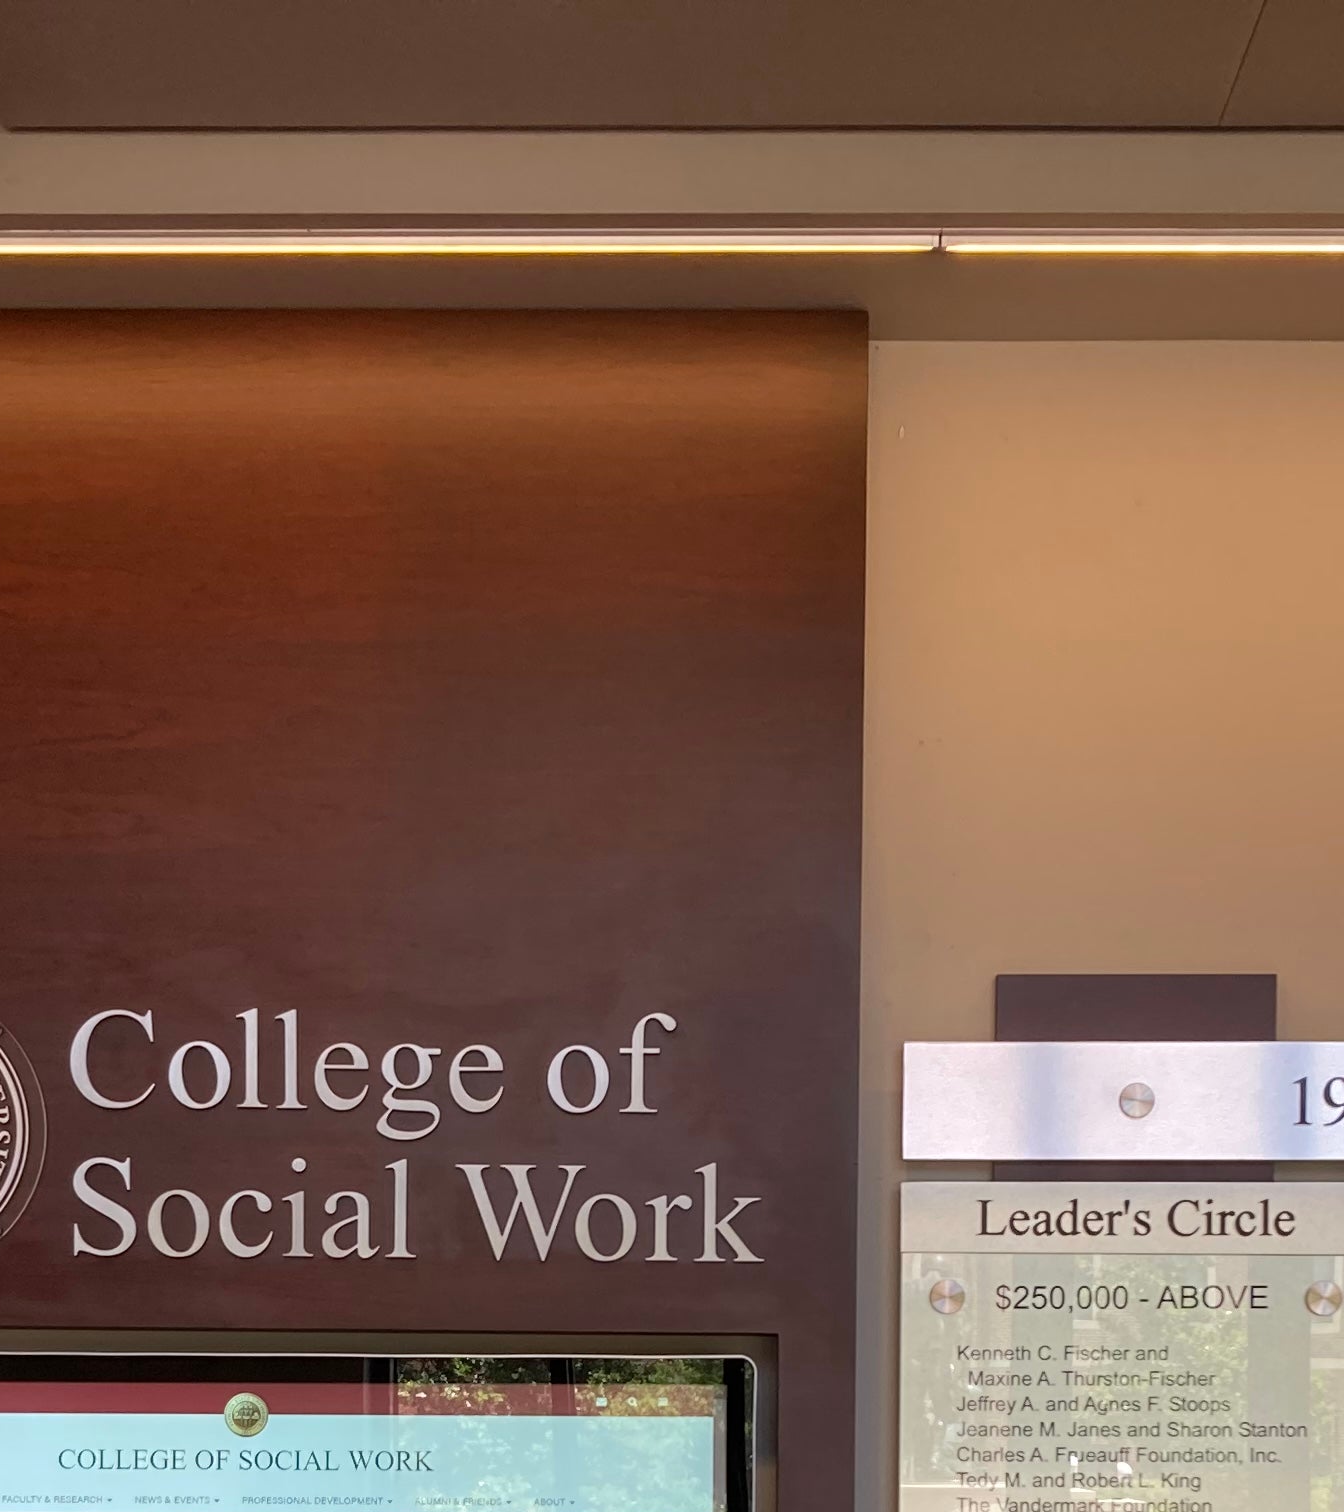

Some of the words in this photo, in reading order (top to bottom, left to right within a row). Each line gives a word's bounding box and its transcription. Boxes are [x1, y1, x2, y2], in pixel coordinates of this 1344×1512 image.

[69, 1007, 505, 1140] College
[547, 1012, 678, 1113] of
[71, 1155, 416, 1259] Social
[455, 1161, 765, 1263] Work
[976, 1198, 1152, 1237] Leader's
[1167, 1198, 1296, 1237] Circle
[996, 1284, 1129, 1313] $250,000
[1157, 1284, 1268, 1309] ABOVE
[957, 1344, 1031, 1361] Kenneth
[1037, 1345, 1057, 1361] C.
[1064, 1345, 1129, 1362] Fischer
[1135, 1345, 1168, 1362] and
[968, 1370, 1032, 1387] Maxine
[1036, 1370, 1056, 1386] A.
[1062, 1371, 1216, 1387] Thurston-Fischer
[956, 1421, 1034, 1438] Jeanene
[1040, 1421, 1060, 1438] M.
[1068, 1421, 1121, 1438] Janes
[1127, 1421, 1161, 1438] and
[1166, 1421, 1232, 1438] Sharon
[1238, 1421, 1308, 1439] Stanton
[58, 1448, 187, 1471] COLLEGE
[195, 1449, 230, 1471] OF
[238, 1449, 340, 1472] SOCIAL
[348, 1450, 435, 1472] WORK
[2, 1495, 42, 1503] FACULTY
[53, 1495, 103, 1504] RESEARCH
[135, 1496, 162, 1504] NEWS
[174, 1496, 210, 1504] EVENTS
[242, 1497, 312, 1505] PROFESSIONAL
[314, 1497, 384, 1505] DEVELOPMENT
[534, 1497, 566, 1506] ABOUT
